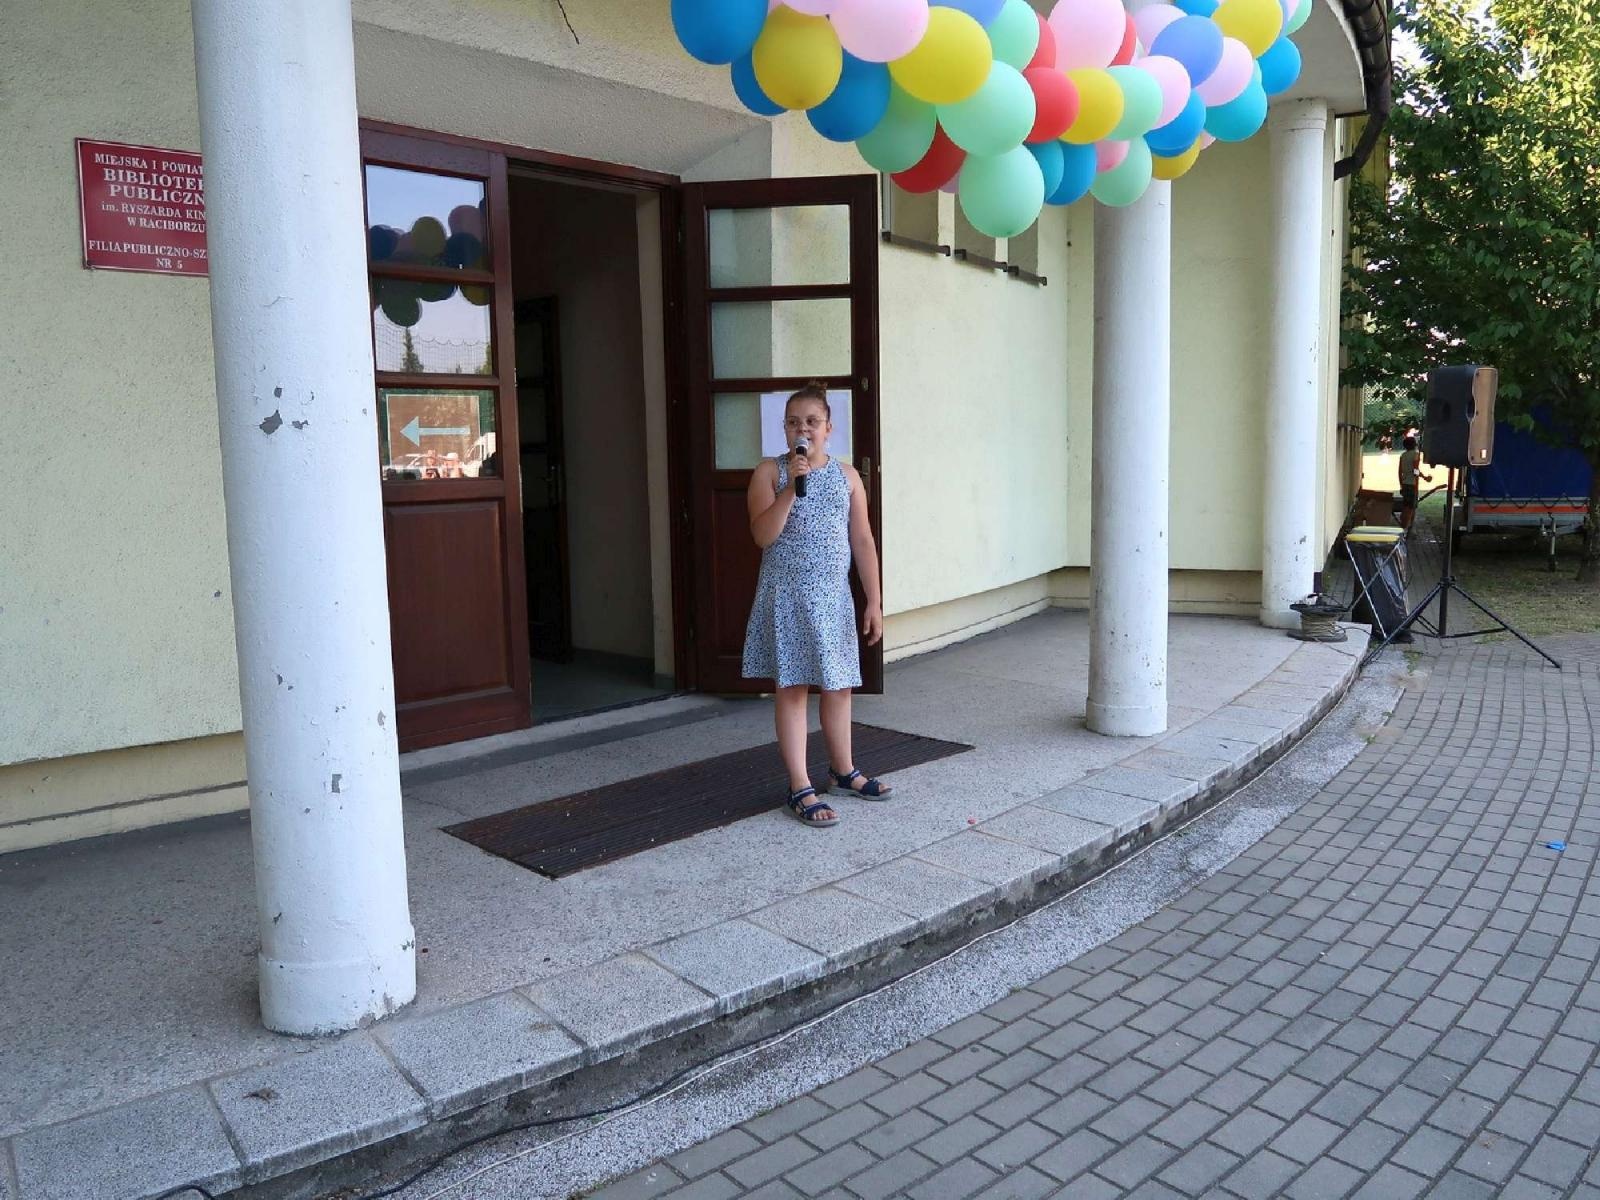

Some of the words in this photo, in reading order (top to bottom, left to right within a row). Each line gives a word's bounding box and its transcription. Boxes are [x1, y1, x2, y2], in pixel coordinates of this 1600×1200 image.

[95, 153, 148, 169] MIEJSKA
[121, 203, 182, 218] RYSZARDA
[127, 217, 137, 227] W
[139, 218, 205, 233] RACIBORZU
[89, 240, 121, 253] FILIA
[156, 258, 172, 269] NR
[177, 260, 183, 269] 5
